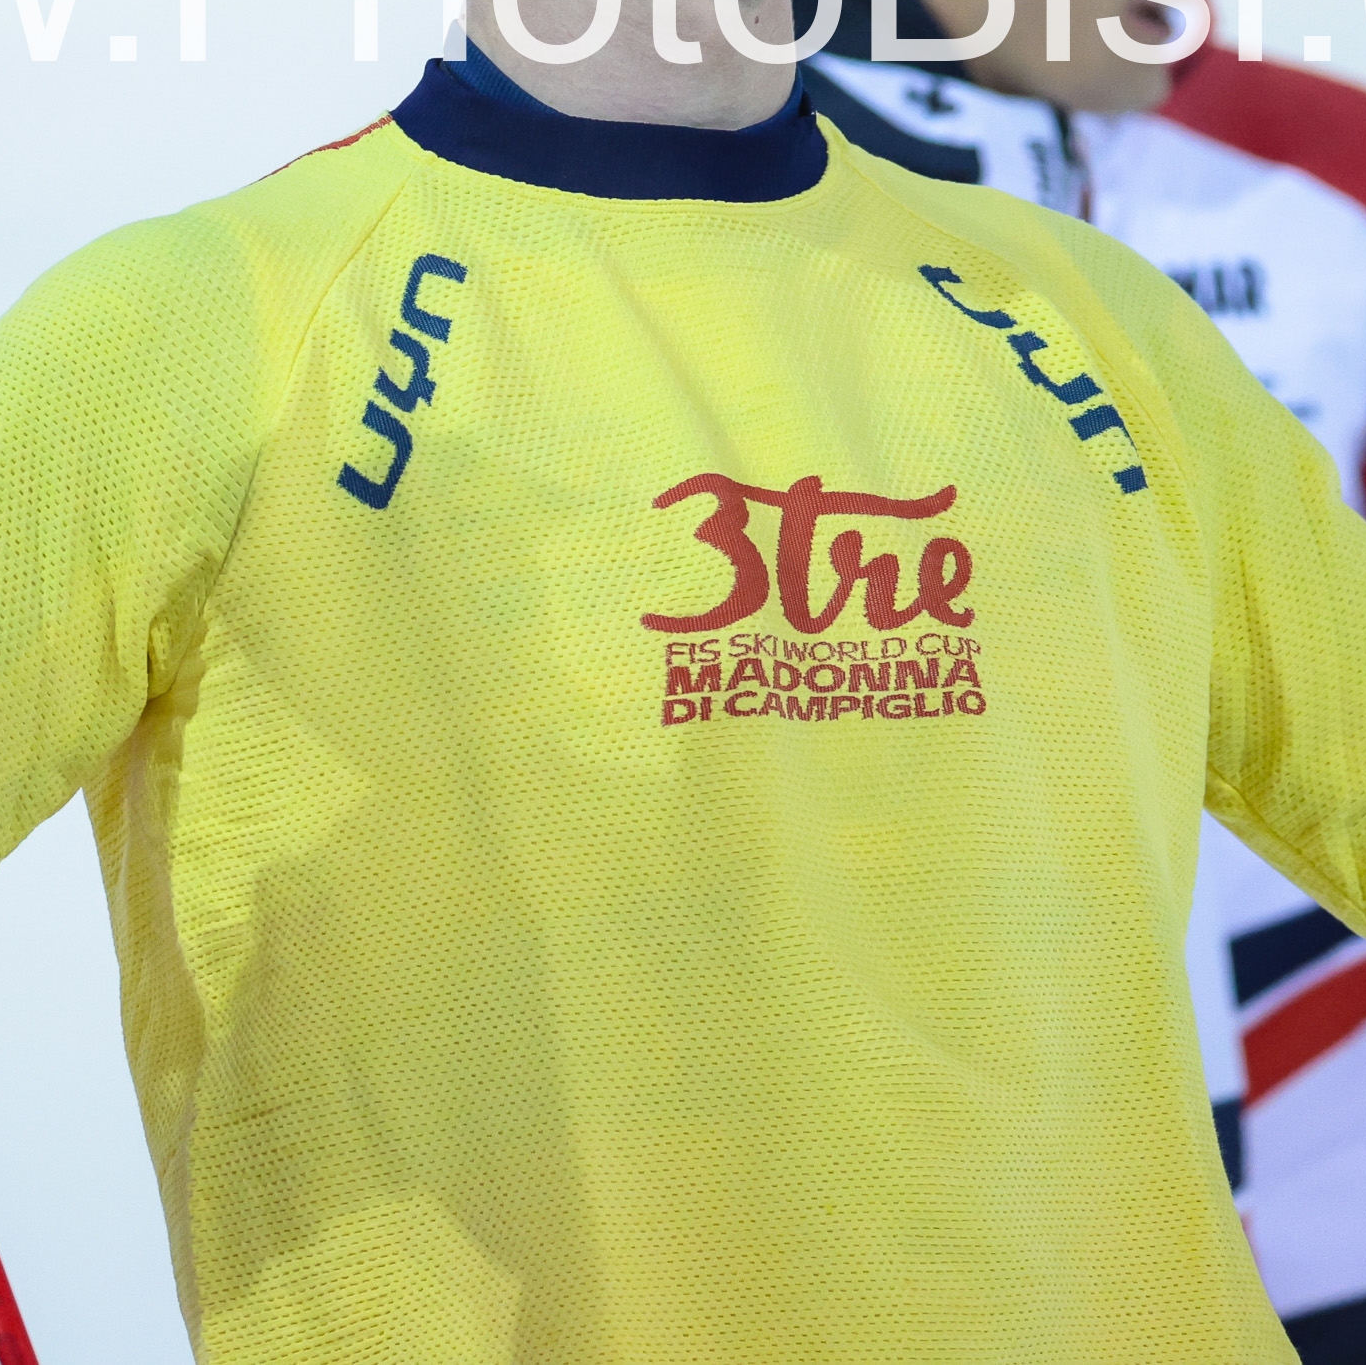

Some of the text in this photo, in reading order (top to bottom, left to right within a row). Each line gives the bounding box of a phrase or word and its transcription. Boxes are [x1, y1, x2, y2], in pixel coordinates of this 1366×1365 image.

[666, 632, 981, 666] FIS SKI WORLD CUP
[665, 658, 982, 696] MADONNA
[661, 689, 987, 727] DI CAMPIGLIO
